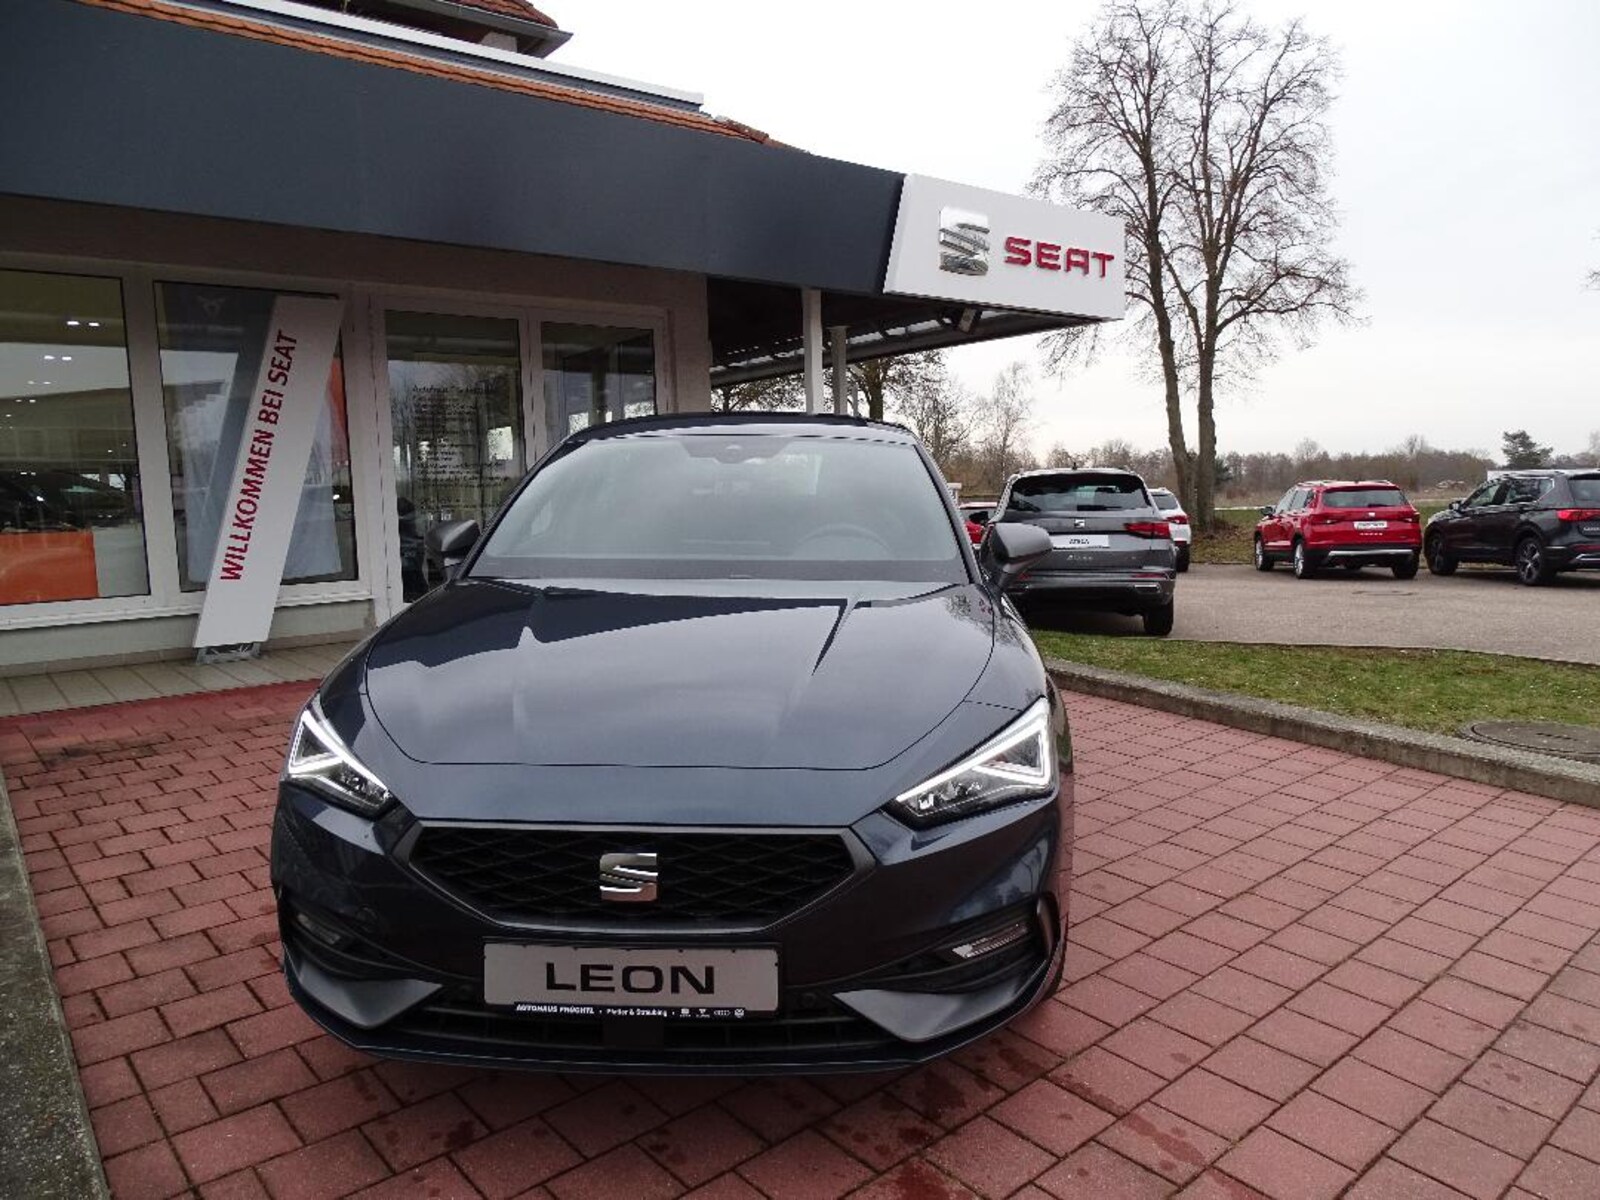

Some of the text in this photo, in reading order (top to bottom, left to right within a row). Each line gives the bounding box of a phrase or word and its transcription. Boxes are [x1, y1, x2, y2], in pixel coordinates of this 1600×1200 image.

[1004, 236, 1115, 278] SEAT
[220, 329, 297, 580] WILLKOMMEN BEI SEAT
[546, 962, 715, 995] LEON
[516, 1003, 558, 1013] AUTOHAUS
